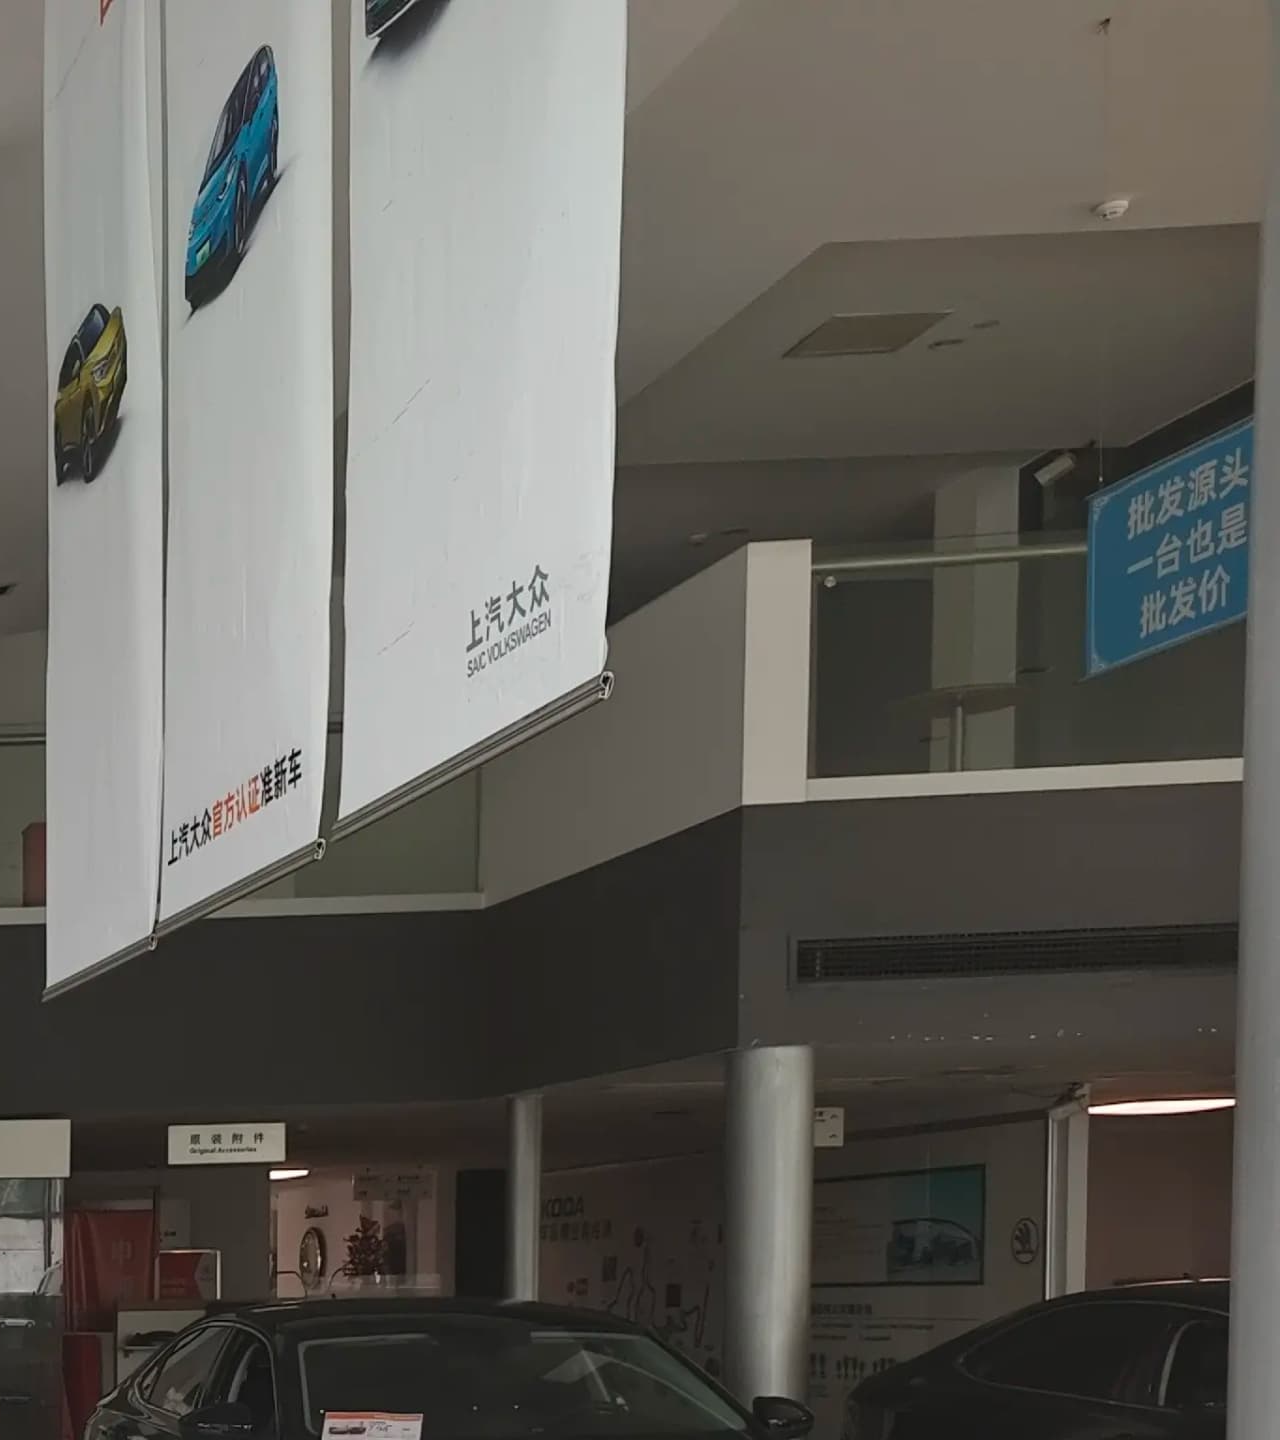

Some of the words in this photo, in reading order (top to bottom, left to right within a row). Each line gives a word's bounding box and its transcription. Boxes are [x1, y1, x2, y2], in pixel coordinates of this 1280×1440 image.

[1127, 447, 1249, 540] 批发源头
[1126, 502, 1248, 579] 一台也是
[465, 564, 550, 653] 上汽大众
[466, 650, 487, 678] SAIC
[487, 608, 552, 668] VOLKSWAGEN
[1140, 564, 1231, 639] 批发价
[167, 748, 302, 866] 上汽大众官方认证准新车
